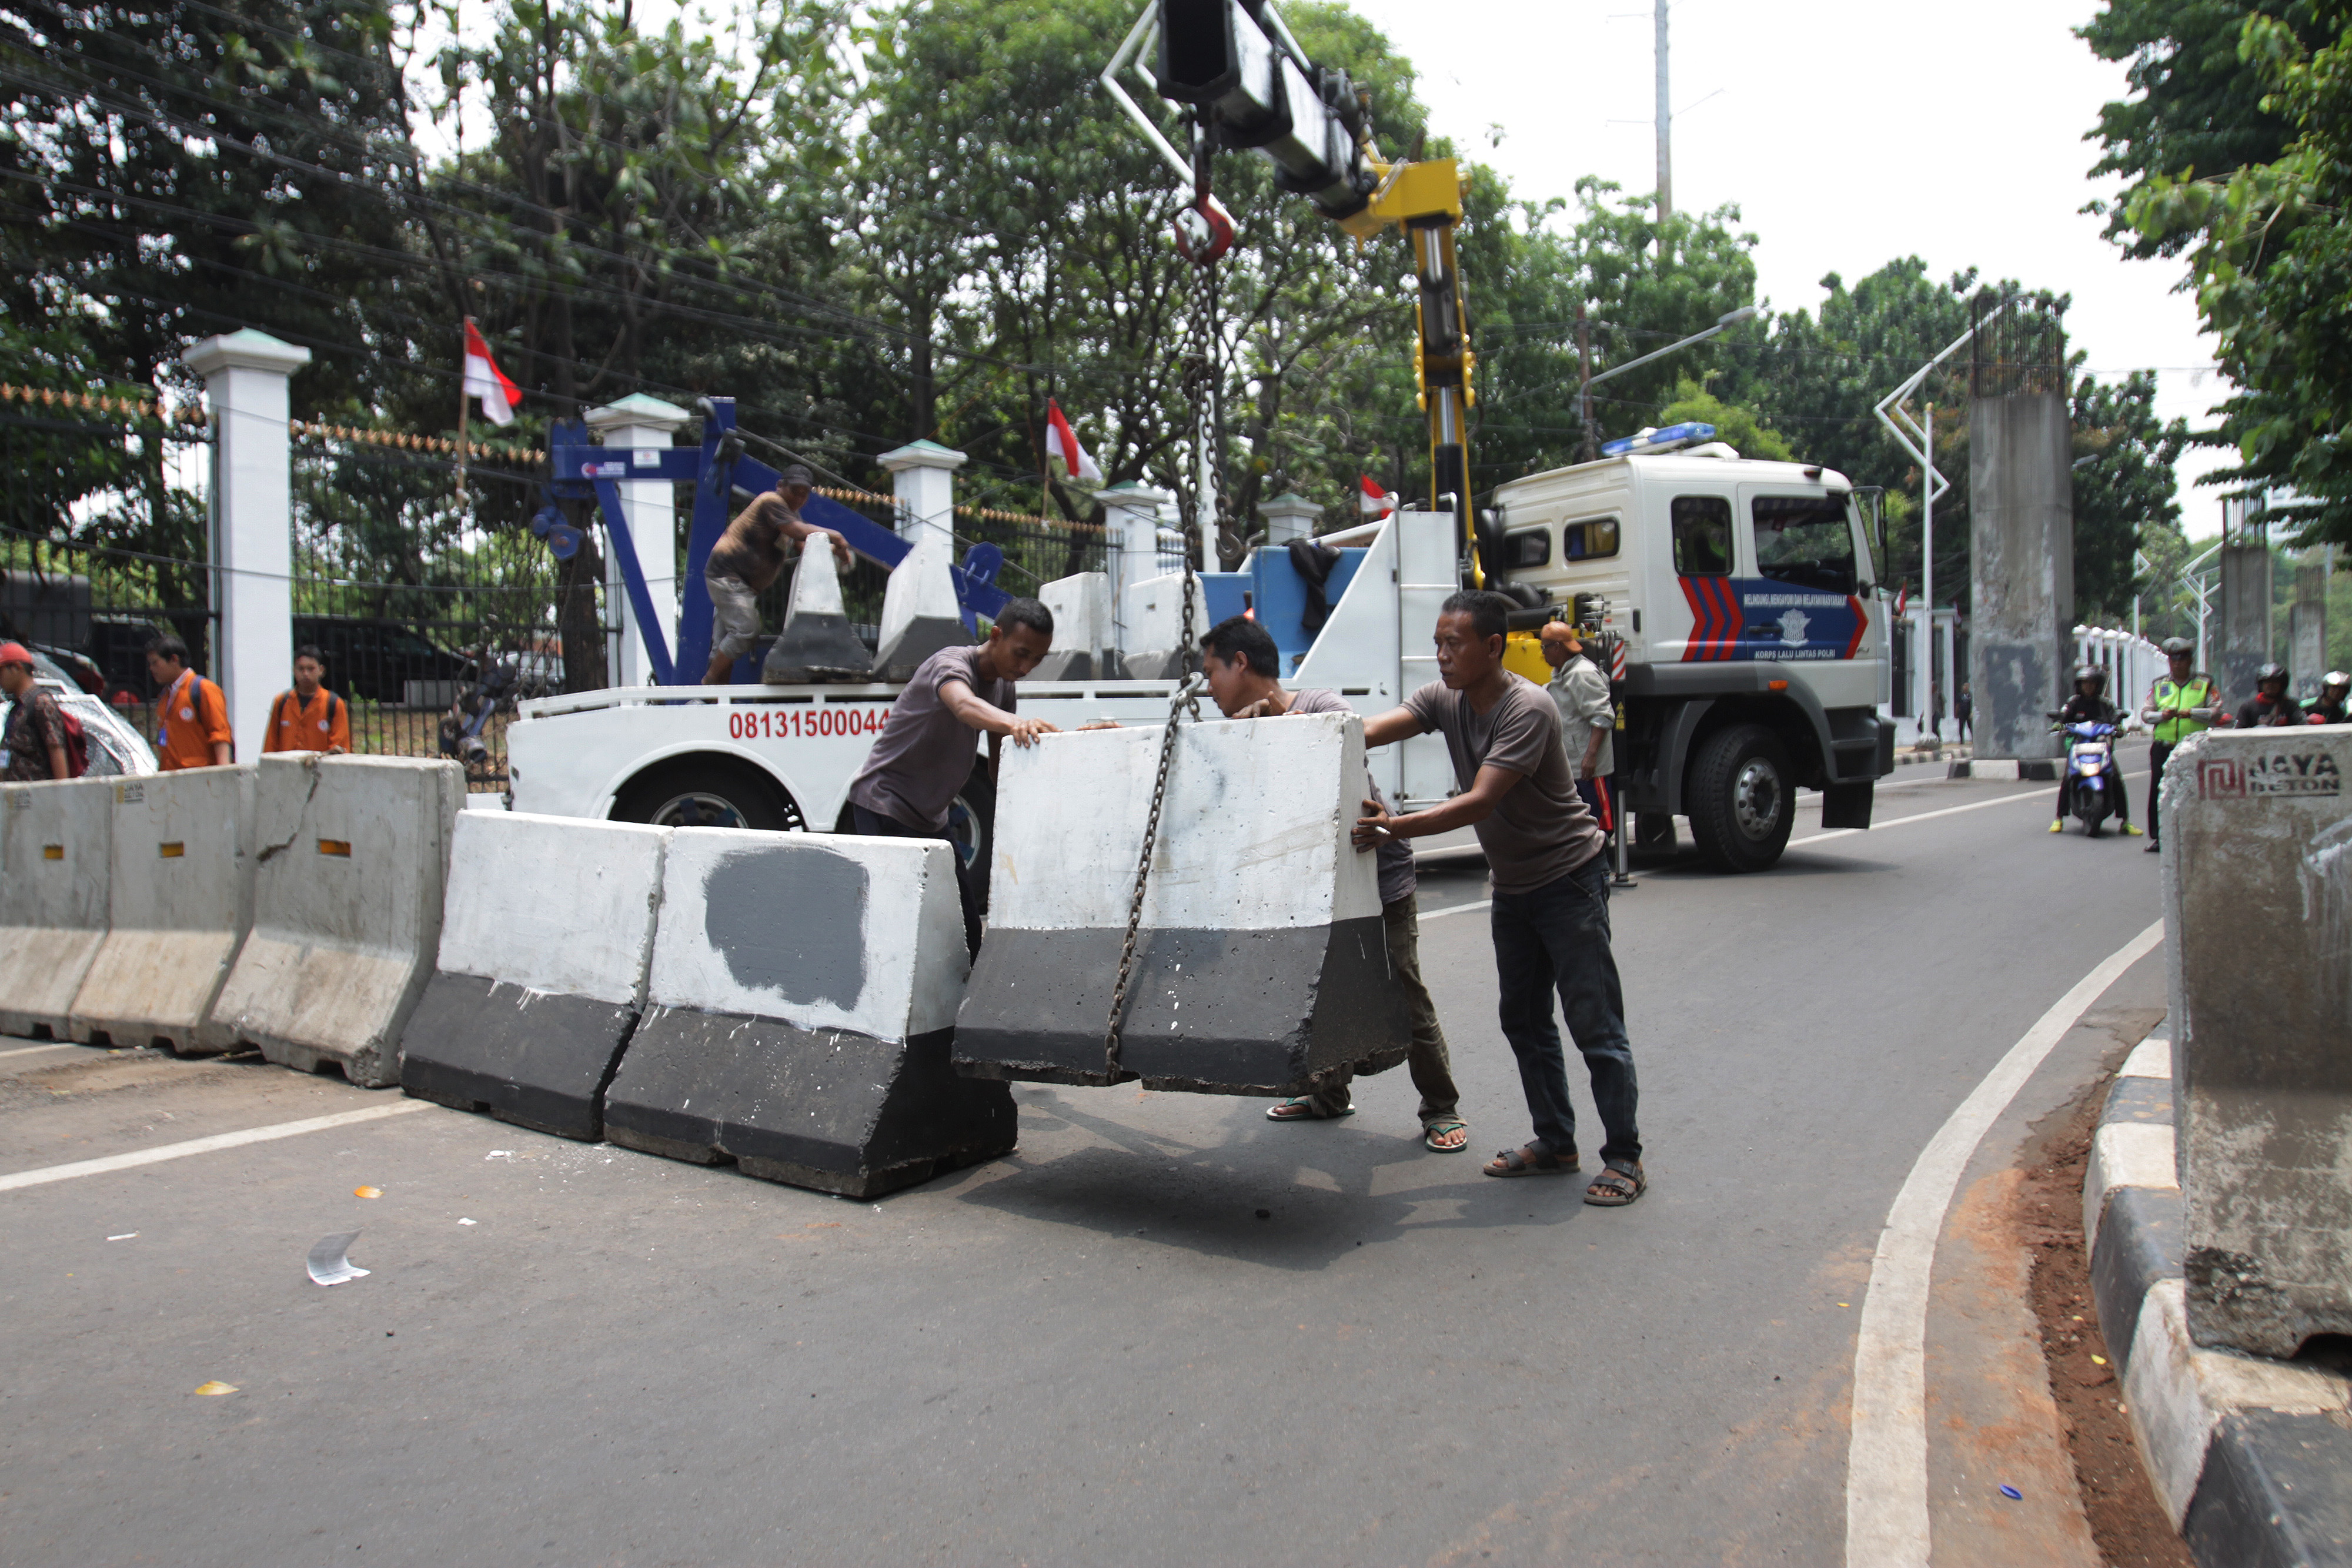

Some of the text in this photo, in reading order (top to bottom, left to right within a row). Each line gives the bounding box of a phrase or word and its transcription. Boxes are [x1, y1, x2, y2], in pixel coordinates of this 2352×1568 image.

[1755, 650, 1776, 658] KORPS
[1818, 649, 1835, 657] POLRI
[2249, 754, 2339, 777] JAYA
[124, 783, 143, 791] JAYA
